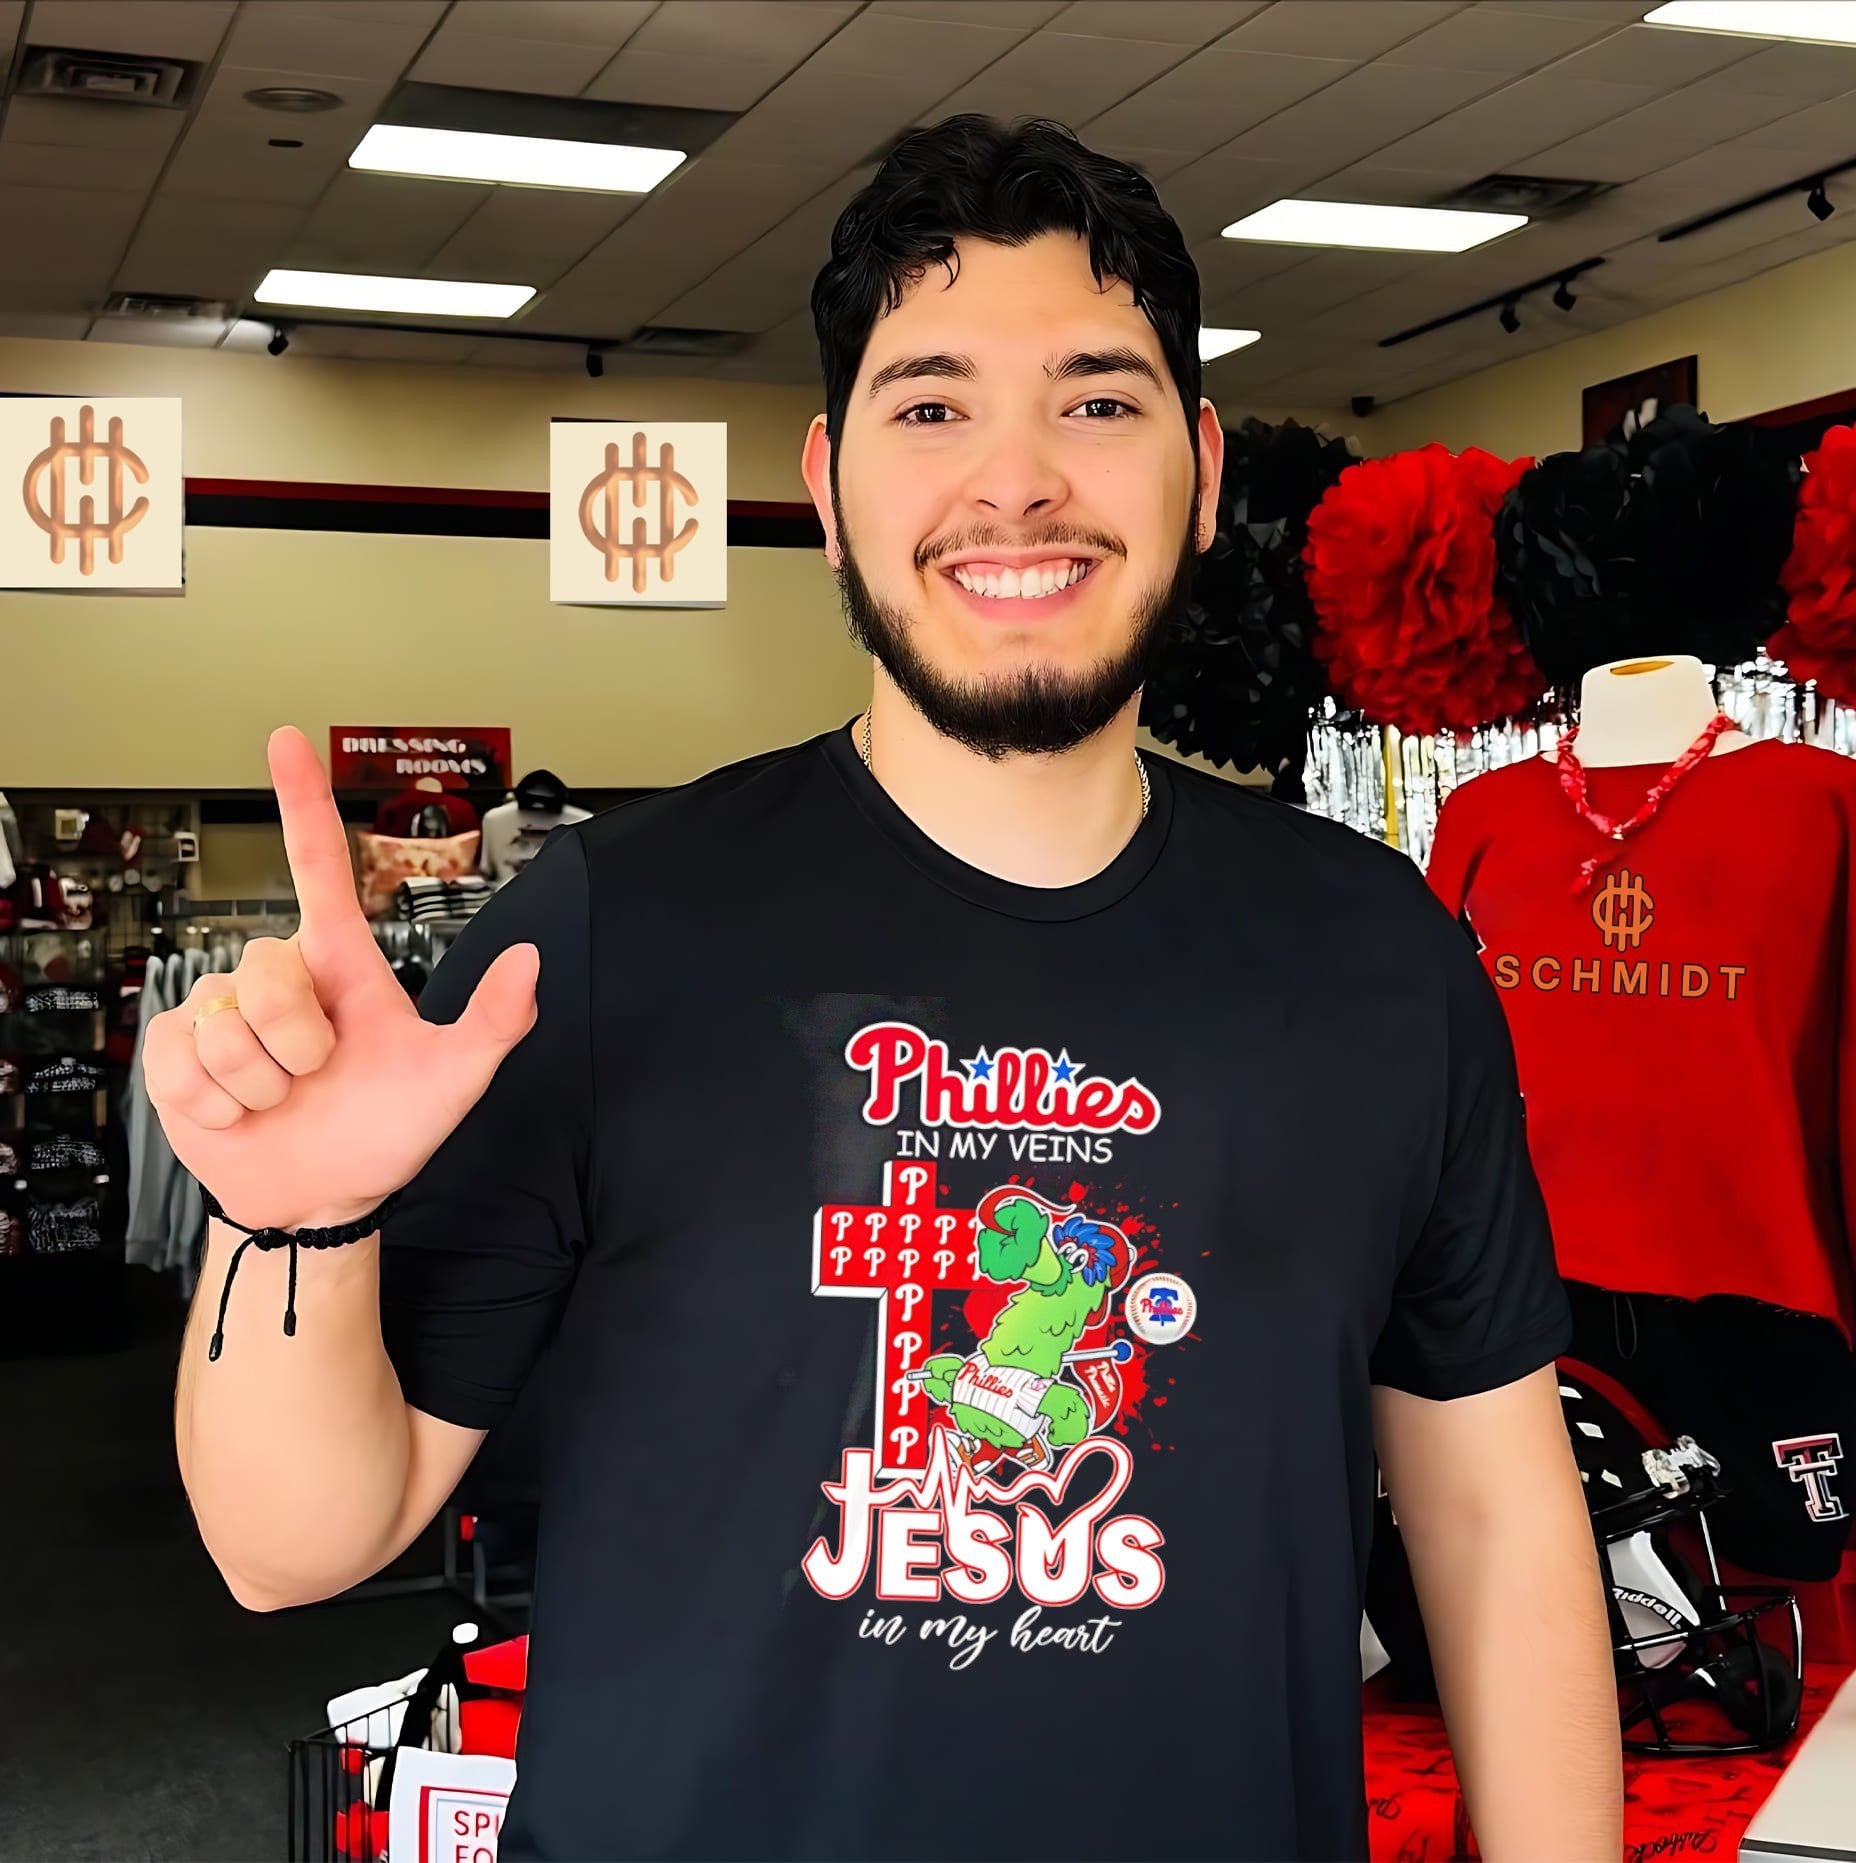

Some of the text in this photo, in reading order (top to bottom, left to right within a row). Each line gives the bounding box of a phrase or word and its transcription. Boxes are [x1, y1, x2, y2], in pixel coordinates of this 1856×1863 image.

[341, 737, 467, 754] DRESSING
[396, 758, 487, 775] ROOMS
[1494, 953, 1746, 1000] SCHMIDT
[845, 1022, 1161, 1135] Phillies
[897, 1130, 1113, 1164] IN MY VEINS
[899, 1166, 928, 1205] P
[831, 1211, 853, 1241] P
[865, 1212, 887, 1242] P
[899, 1213, 921, 1244] P
[934, 1215, 957, 1245] P
[830, 1246, 852, 1276] P
[863, 1247, 886, 1278] P
[897, 1248, 920, 1279] P
[933, 1250, 955, 1280] P
[895, 1283, 924, 1322] P
[893, 1331, 922, 1370] P
[892, 1378, 921, 1416] P
[958, 1361, 1013, 1399] Phillies
[890, 1426, 919, 1465] P
[802, 1445, 1166, 1610] JESUS
[858, 1606, 1122, 1670] in my heart
